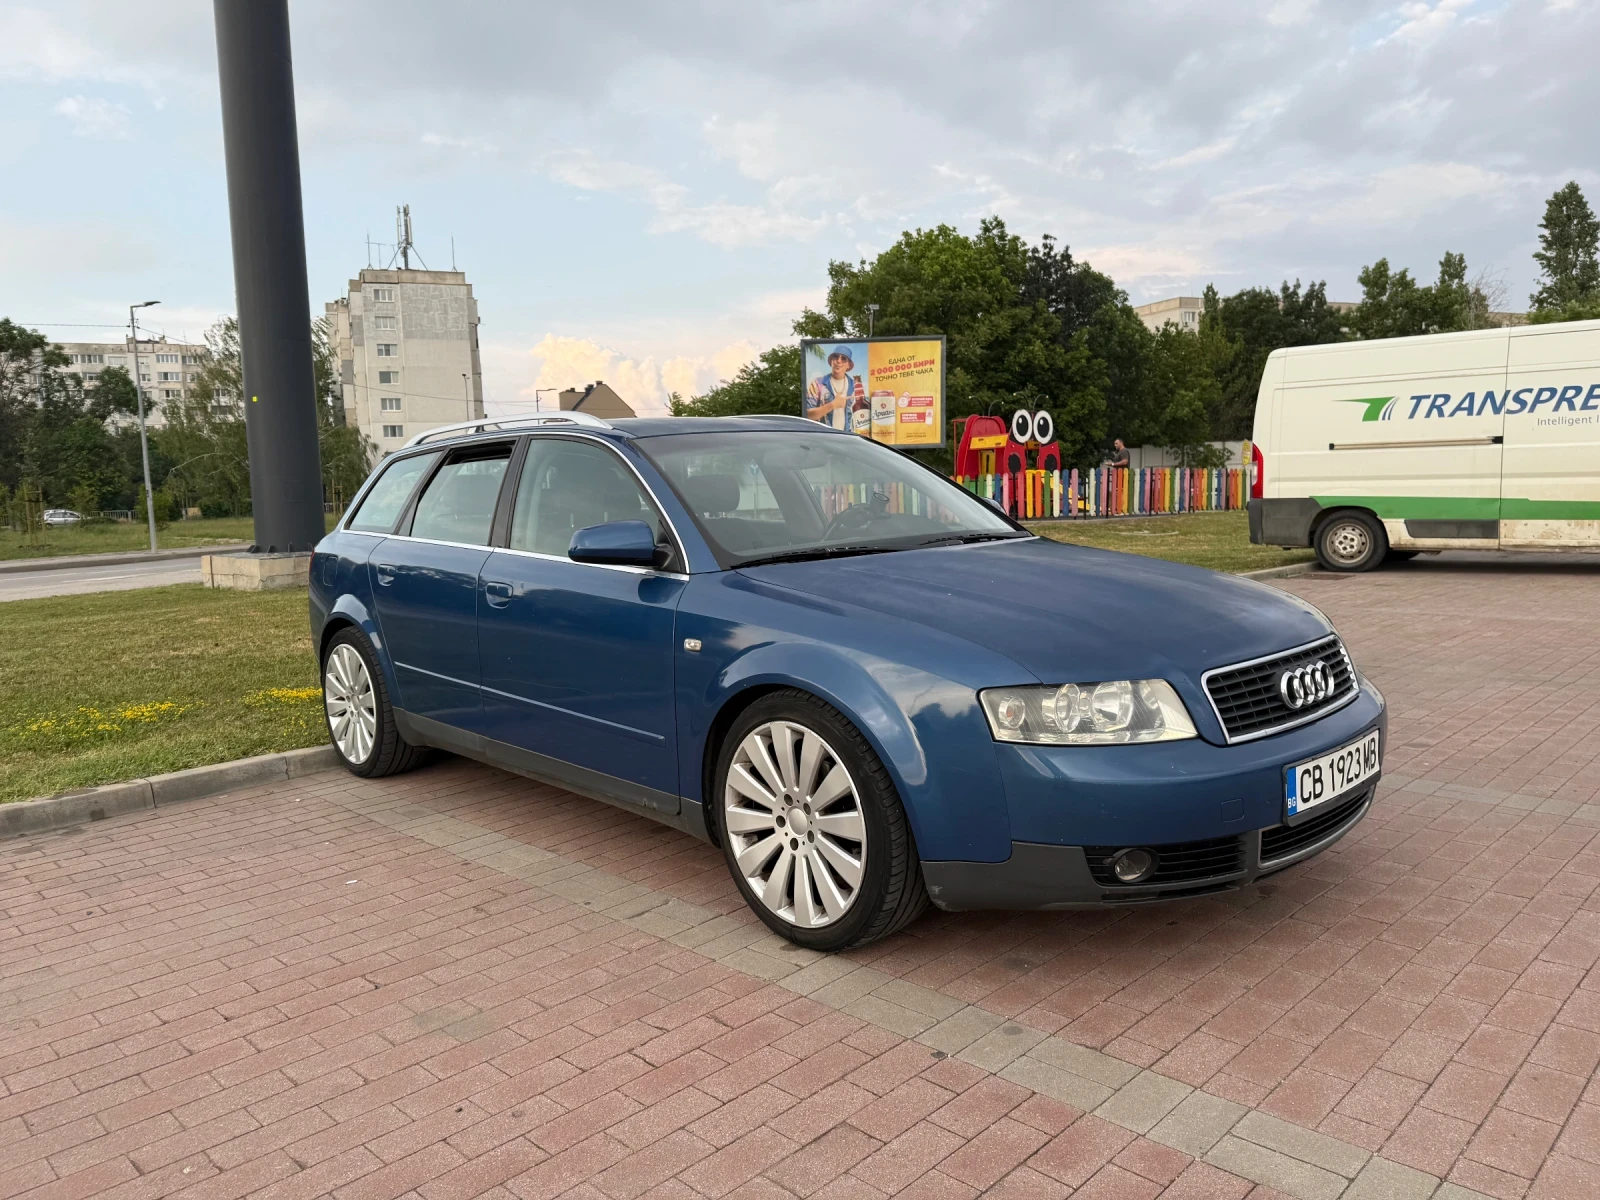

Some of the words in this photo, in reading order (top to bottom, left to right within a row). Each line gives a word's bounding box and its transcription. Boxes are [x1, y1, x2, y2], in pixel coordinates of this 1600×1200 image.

[877, 365, 894, 375] 000
[895, 362, 912, 372] 000
[913, 358, 935, 368] БИРИ
[888, 356, 906, 365] ЕДНА
[875, 373, 898, 382] ТОЧНО
[898, 370, 914, 378] ТЕБЕ
[915, 367, 934, 375] ЧАКА
[1537, 416, 1593, 427] Intelligent
[1300, 764, 1324, 804] CB
[1329, 746, 1361, 792] 1923
[1363, 737, 1377, 775] MB
[1287, 797, 1297, 809] BG
